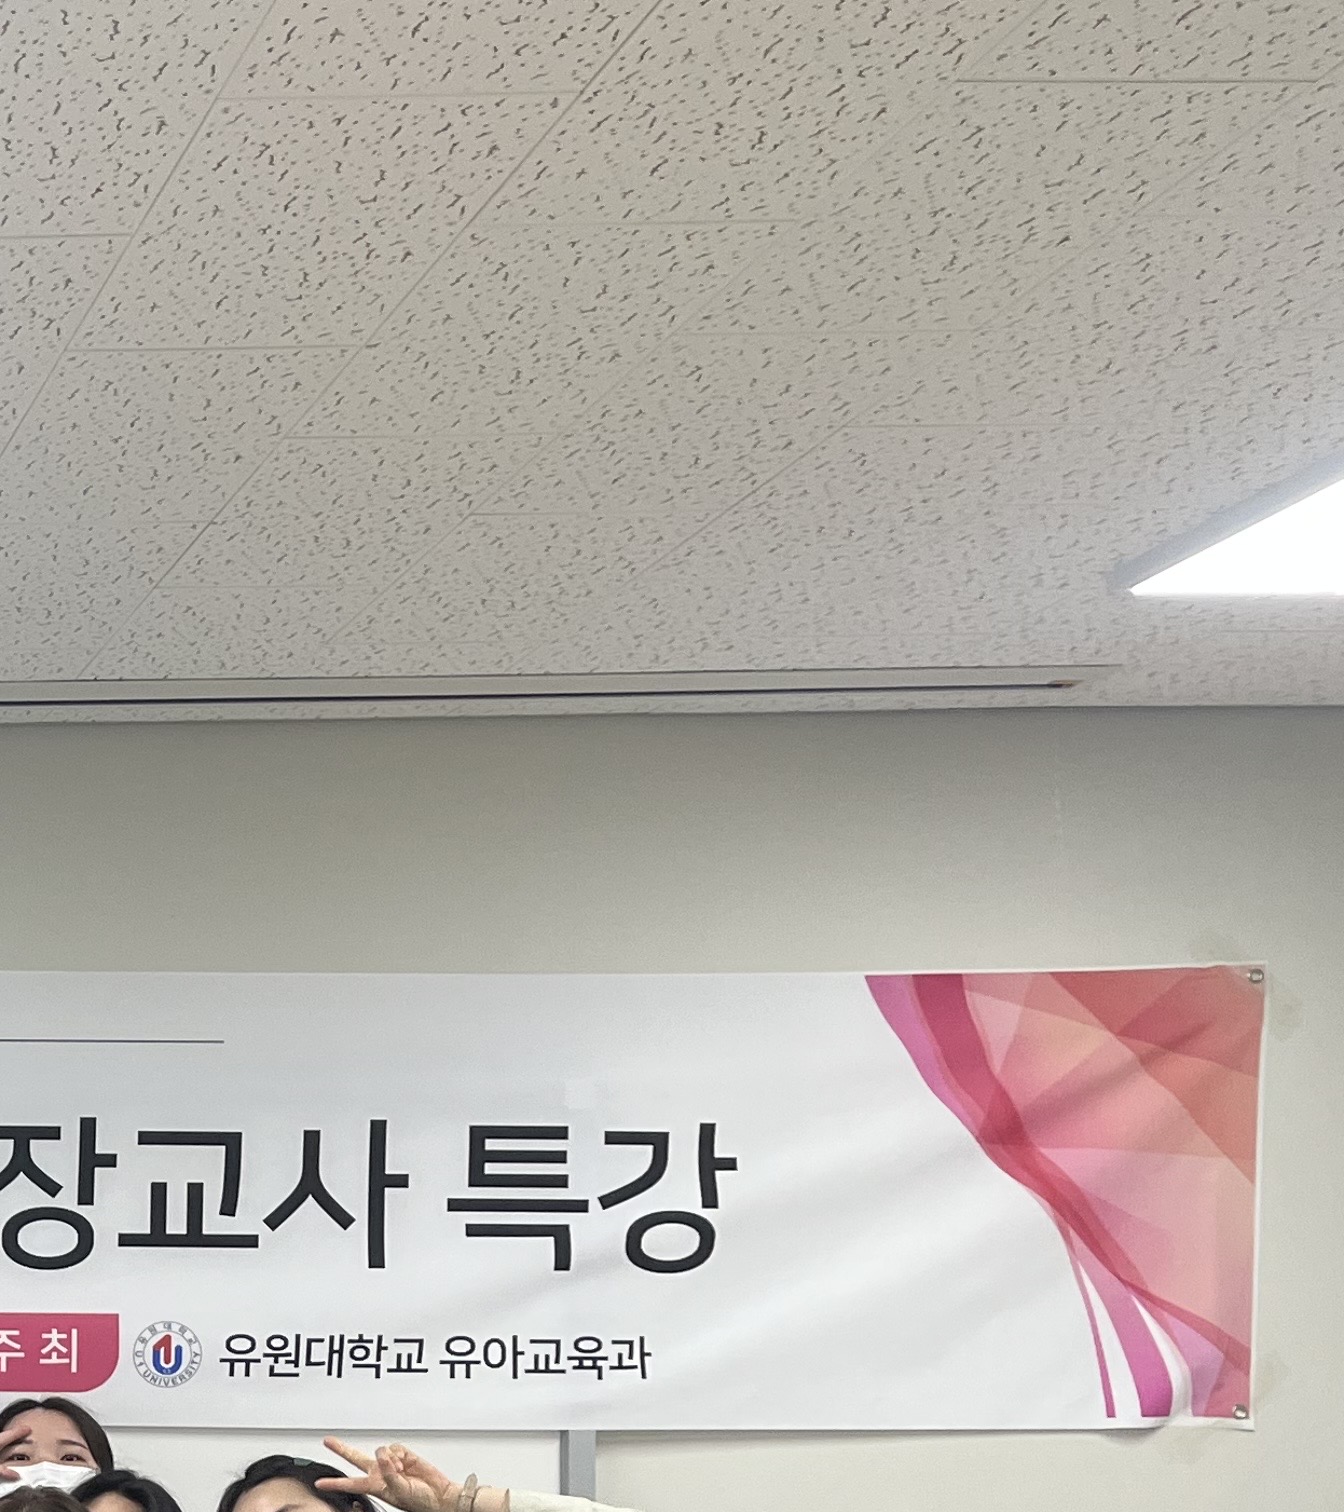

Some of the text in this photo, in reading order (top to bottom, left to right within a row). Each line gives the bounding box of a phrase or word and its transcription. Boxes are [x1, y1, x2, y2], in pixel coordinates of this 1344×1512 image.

[446, 1122, 739, 1275] 특강
[218, 1333, 429, 1380] 유원대학교
[438, 1334, 653, 1381] 유아교육과
